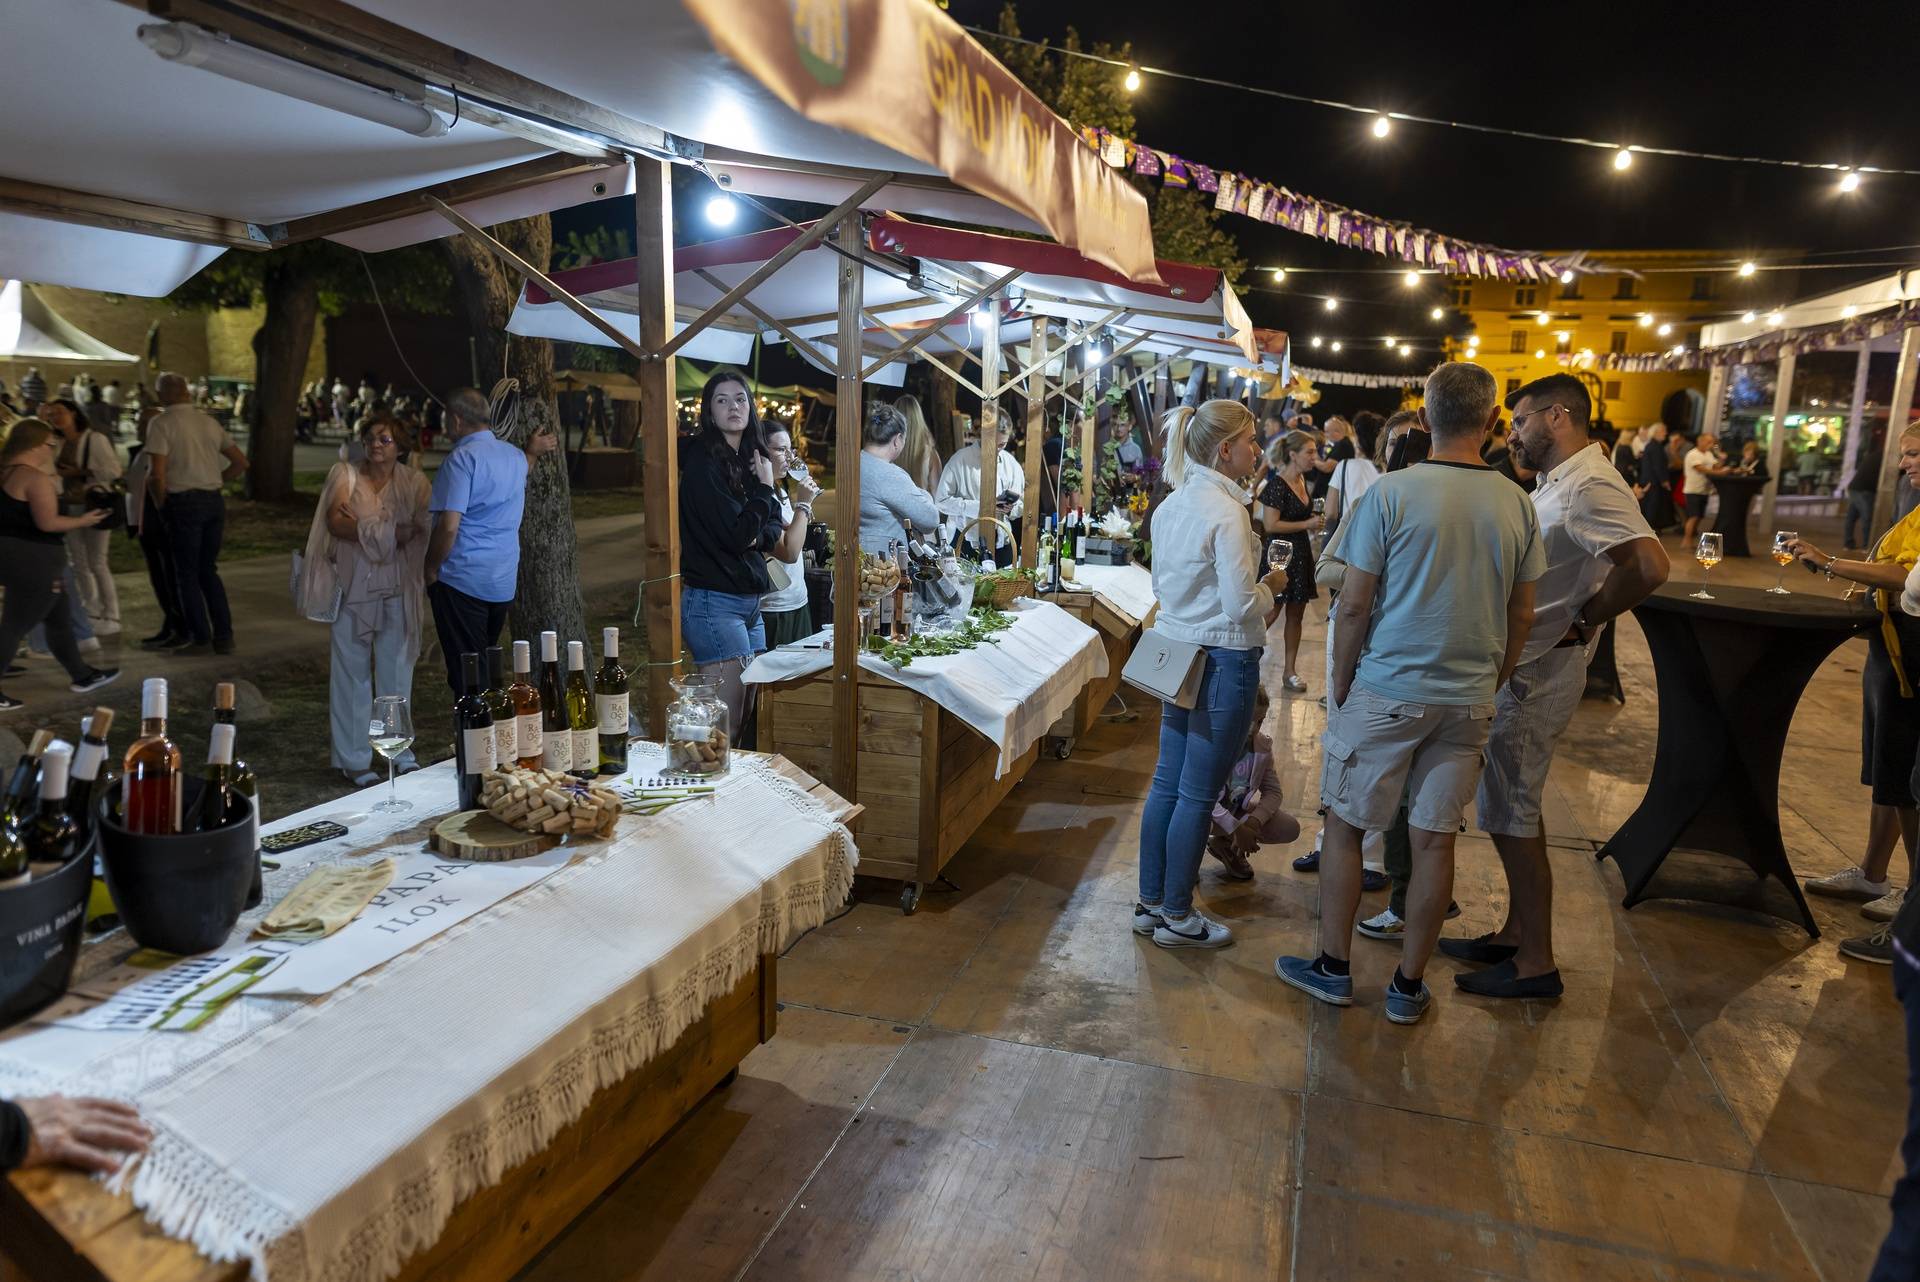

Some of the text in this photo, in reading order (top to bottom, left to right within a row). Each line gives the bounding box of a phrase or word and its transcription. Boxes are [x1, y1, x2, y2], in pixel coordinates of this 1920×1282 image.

[919, 22, 996, 156] GRAD
[367, 863, 474, 908] PAPA
[16, 923, 52, 947] VINA
[374, 895, 462, 934] ILOK
